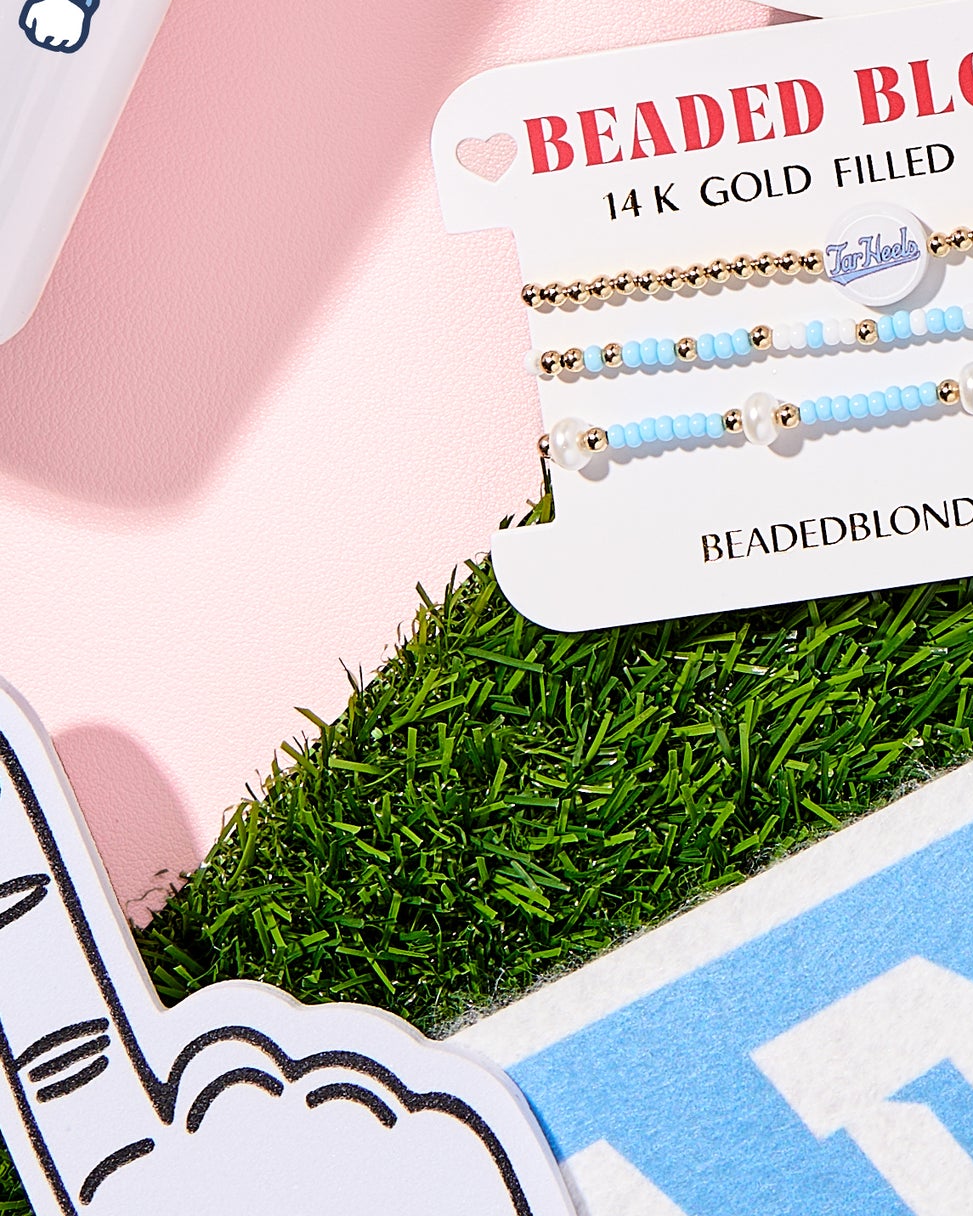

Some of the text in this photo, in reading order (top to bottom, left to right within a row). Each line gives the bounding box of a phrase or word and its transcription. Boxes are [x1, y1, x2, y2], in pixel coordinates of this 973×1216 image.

[523, 78, 825, 175] BEADED
[700, 164, 813, 207] GOLD
[834, 144, 956, 189] FILLED
